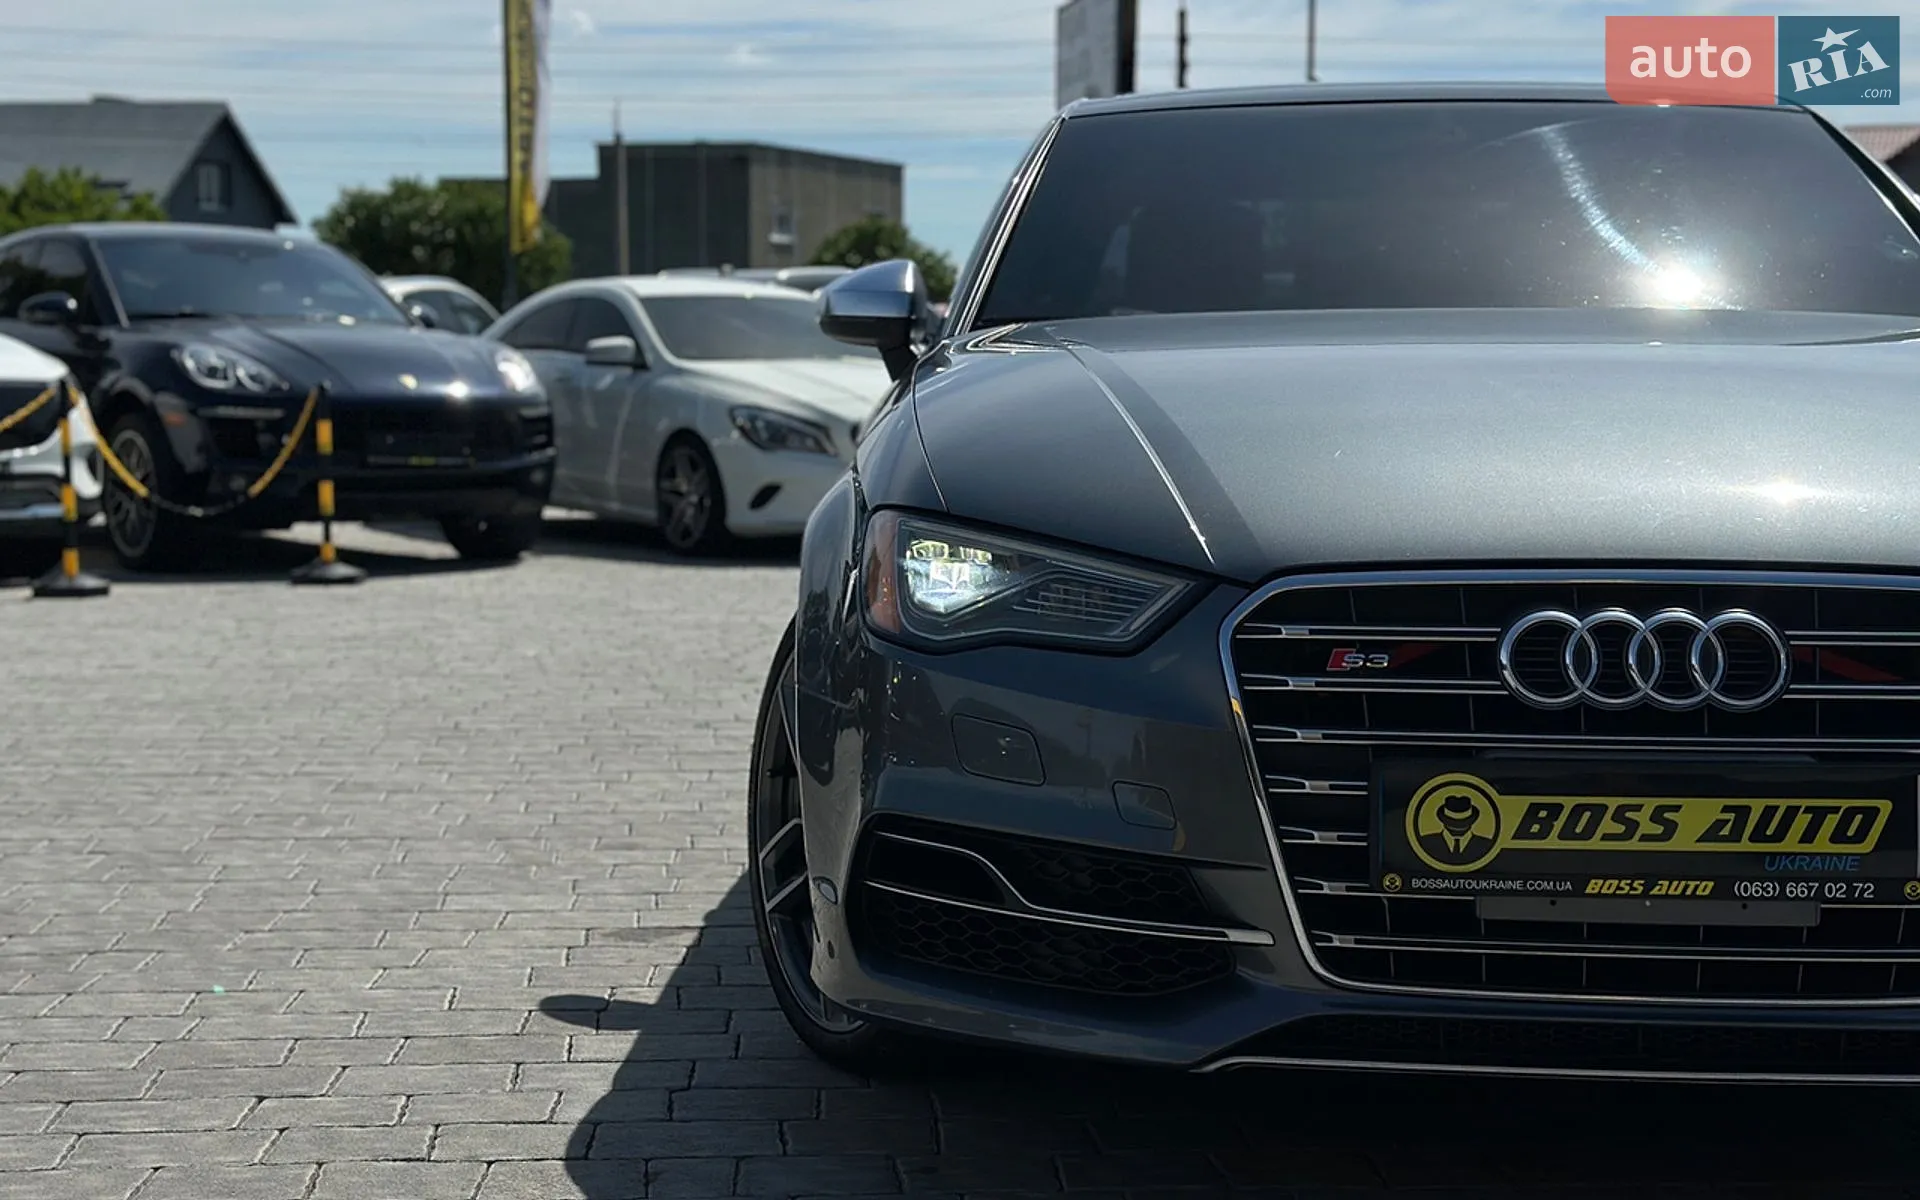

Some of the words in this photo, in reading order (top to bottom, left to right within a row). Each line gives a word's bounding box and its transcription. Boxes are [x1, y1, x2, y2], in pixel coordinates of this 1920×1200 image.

[1341, 652, 1389, 668] S3
[1510, 801, 1684, 843] BOSS
[1694, 804, 1882, 845] AUTO
[1763, 855, 1862, 872] UKRAINE
[1411, 877, 1573, 892] BOSSAUTOUKRAINE.COM.UA
[1584, 878, 1646, 895] BOSS
[1649, 879, 1716, 896] AUTO
[1733, 880, 1781, 898] (063)
[1785, 881, 1820, 898] 667
[1823, 882, 1847, 899] 02
[1852, 882, 1876, 899] 72
